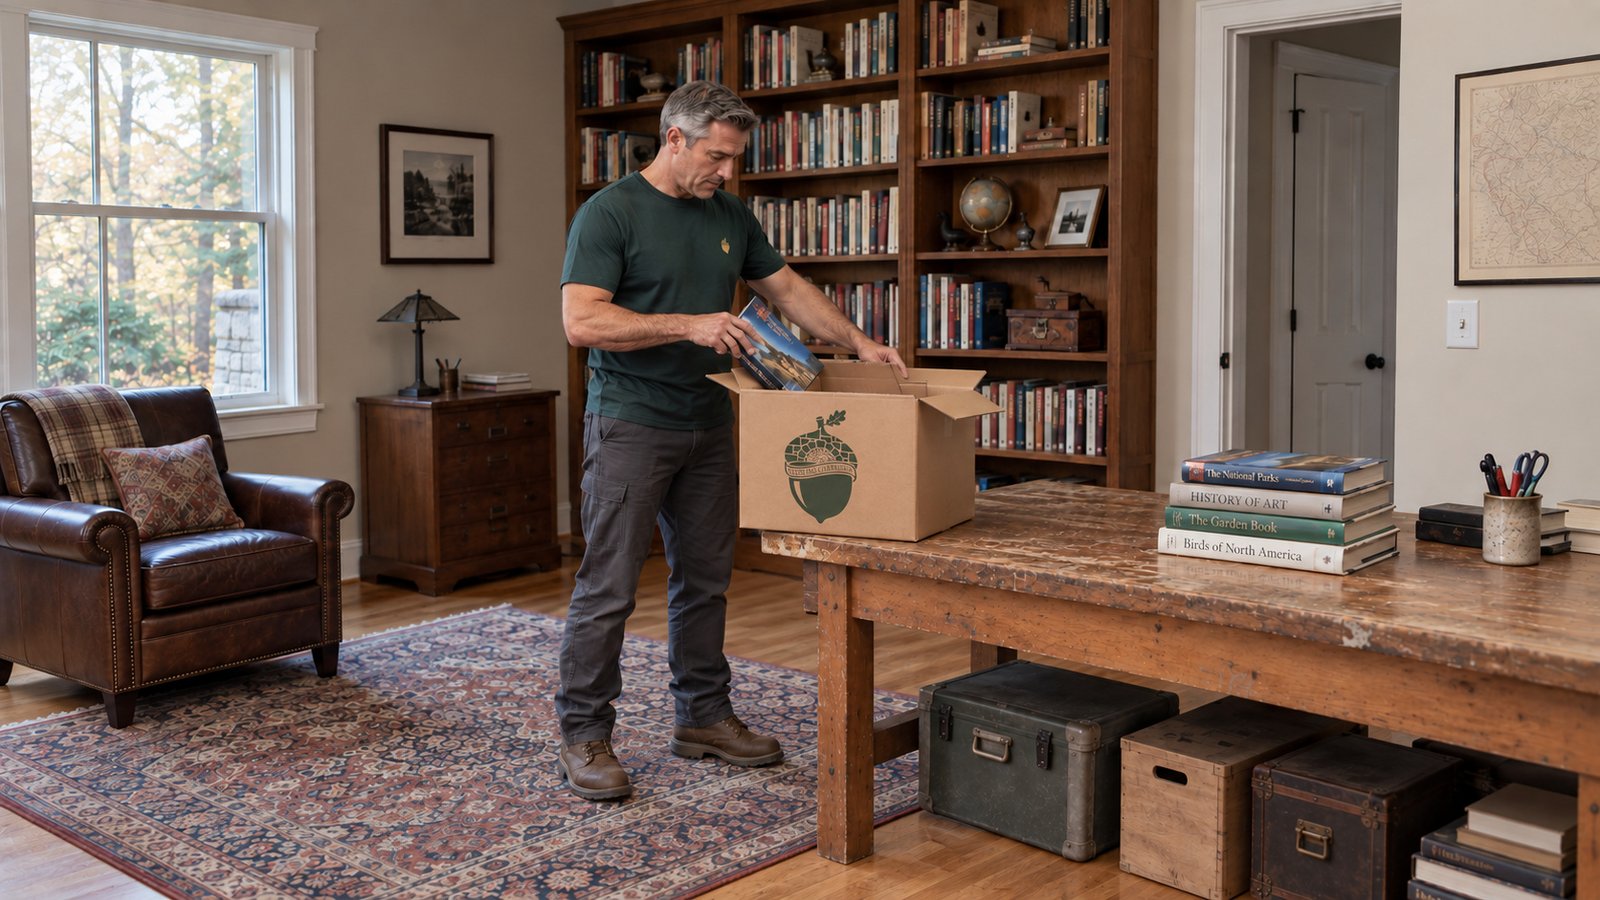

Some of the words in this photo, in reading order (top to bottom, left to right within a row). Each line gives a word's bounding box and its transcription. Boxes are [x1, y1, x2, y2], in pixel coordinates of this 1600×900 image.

[1206, 468, 1222, 479] The
[1223, 470, 1255, 482] National
[1257, 472, 1280, 483] Parks
[1191, 491, 1243, 507] HISTORY
[1245, 496, 1261, 507] OF
[1263, 498, 1288, 510] ART
[1188, 513, 1209, 526] The
[1211, 516, 1248, 530] Garden
[1251, 520, 1278, 534] Book
[1183, 538, 1210, 552] Birds
[1212, 541, 1223, 552] of
[1225, 542, 1257, 556] North
[1258, 545, 1303, 562] America
